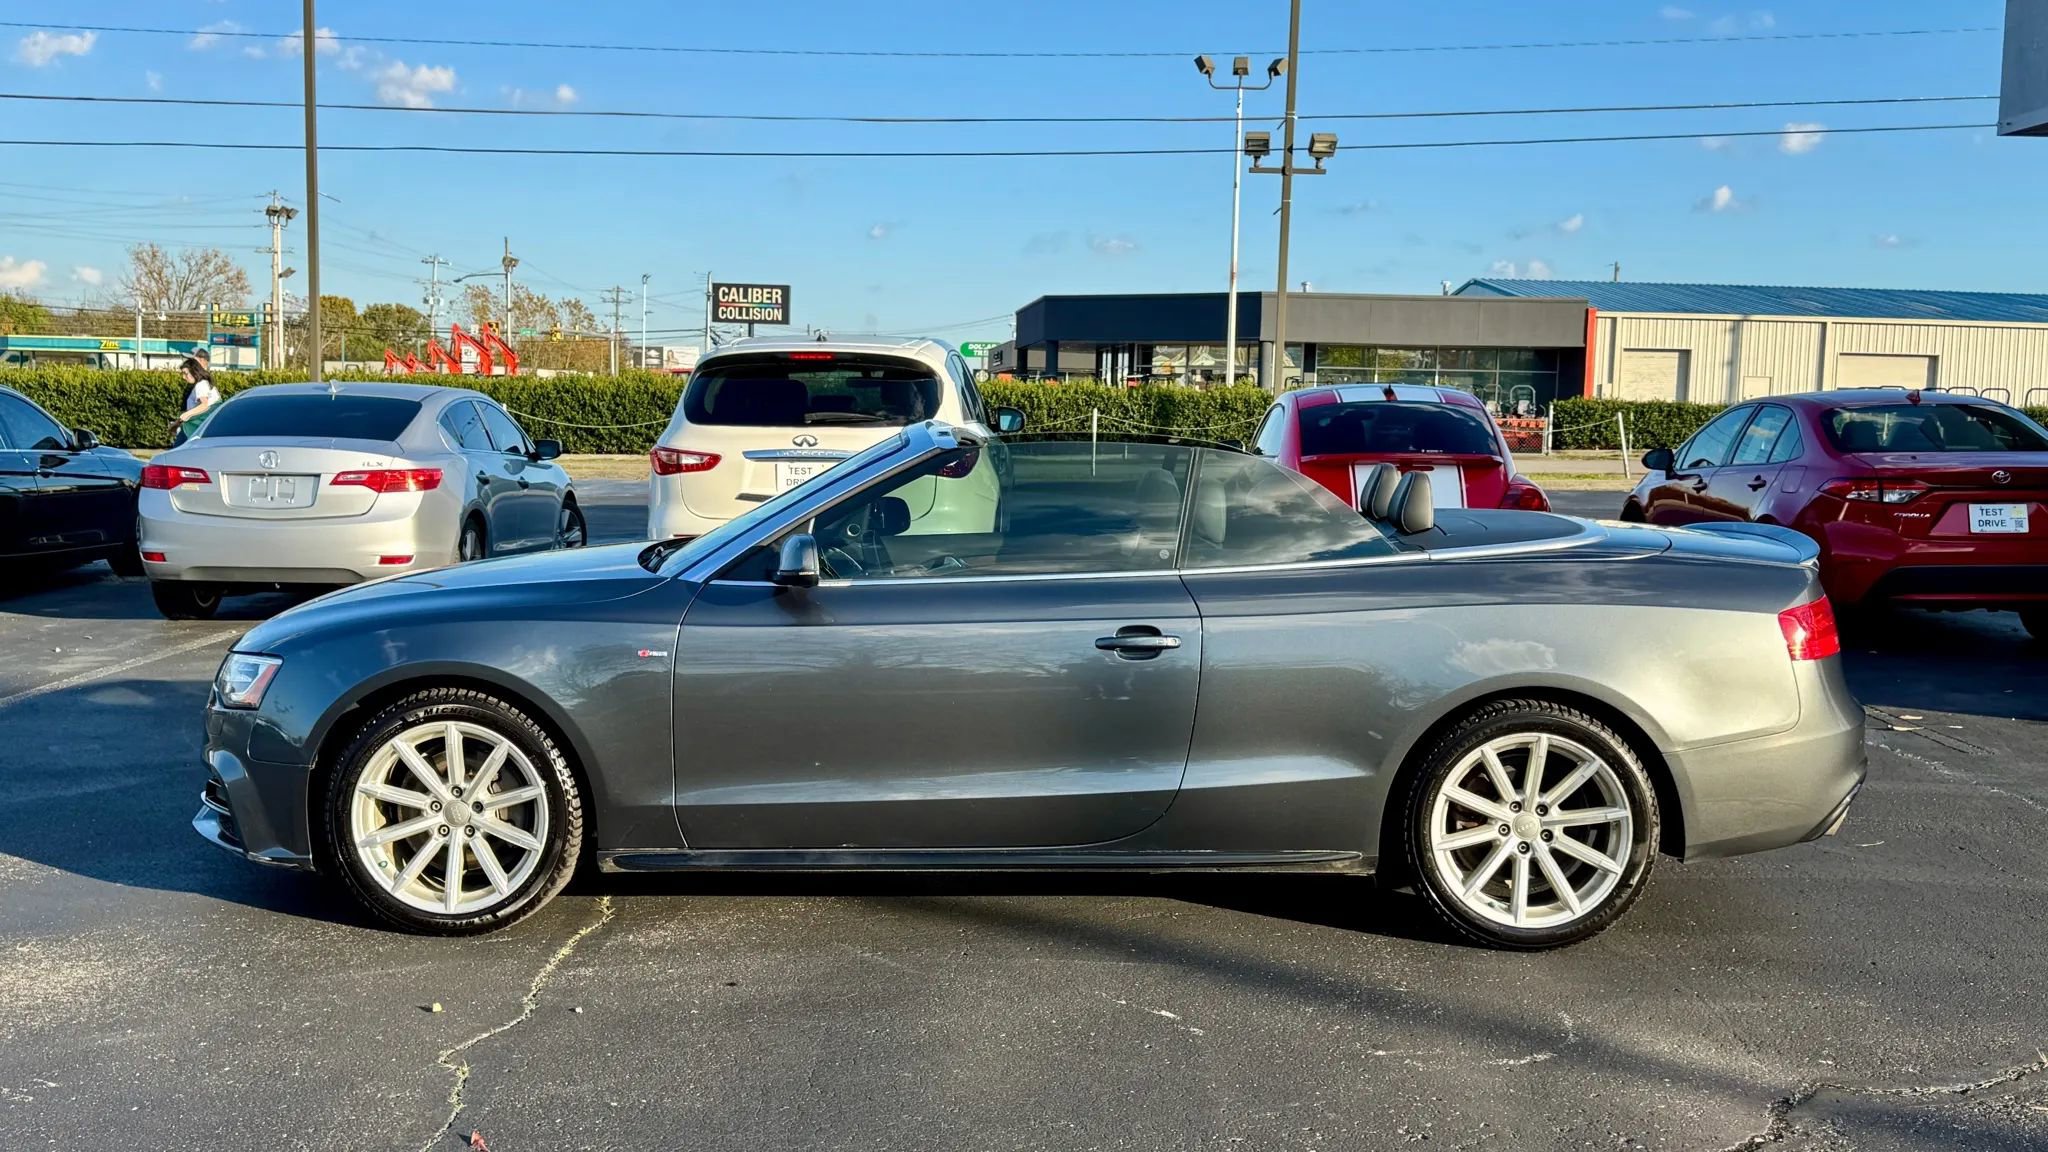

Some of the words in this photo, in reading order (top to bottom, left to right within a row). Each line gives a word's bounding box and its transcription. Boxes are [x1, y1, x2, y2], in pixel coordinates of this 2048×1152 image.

[718, 286, 782, 304] CALIBER
[718, 306, 783, 321] COLLISION
[789, 467, 813, 475] TEST
[786, 478, 806, 486] DRI
[1979, 508, 2004, 516] TEST
[1978, 519, 2007, 527] DRIVE
